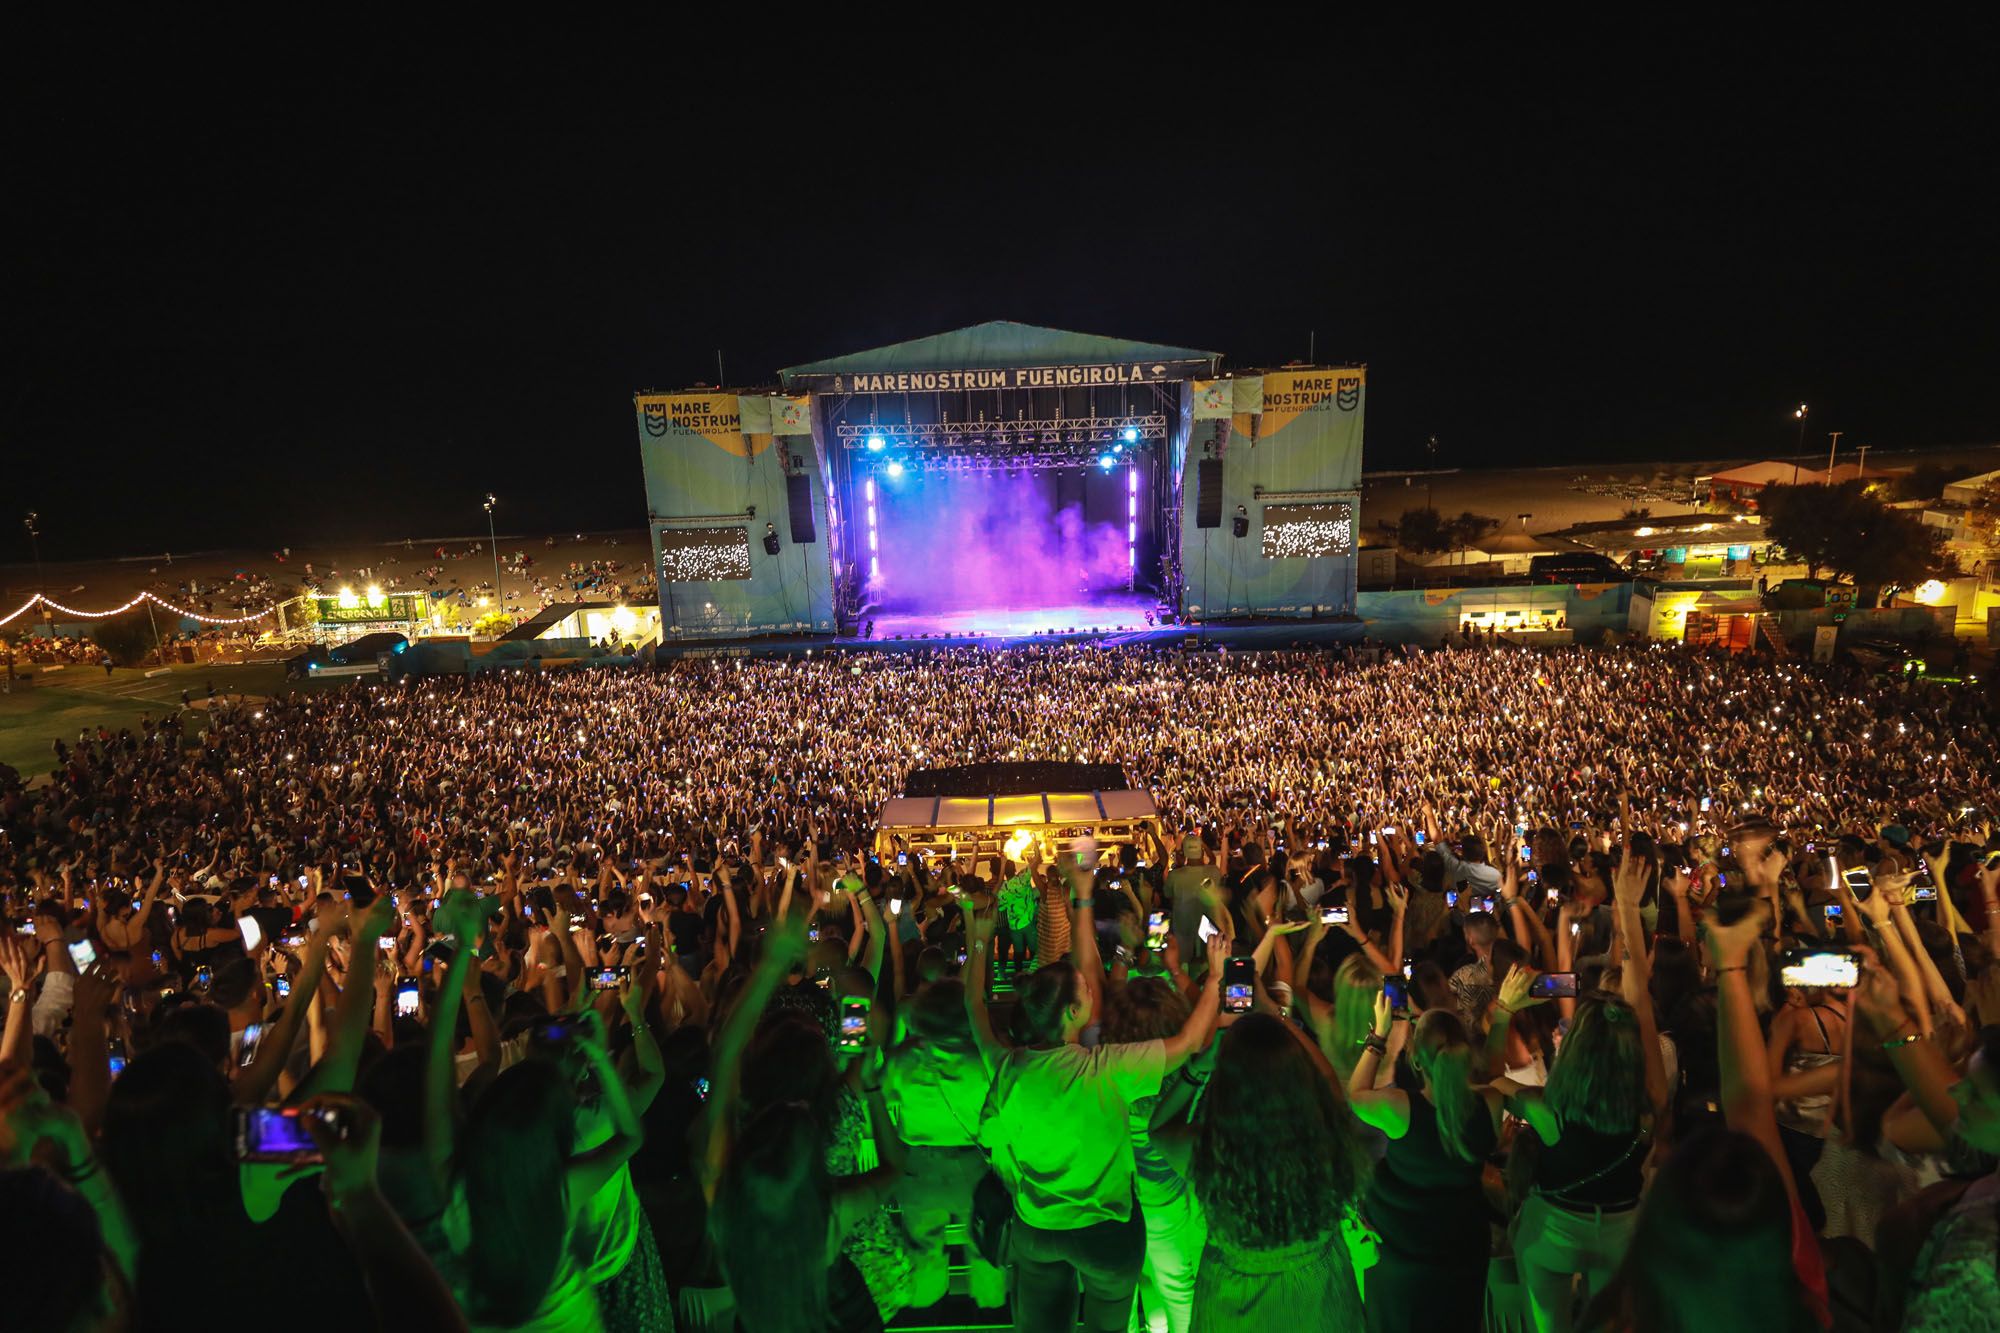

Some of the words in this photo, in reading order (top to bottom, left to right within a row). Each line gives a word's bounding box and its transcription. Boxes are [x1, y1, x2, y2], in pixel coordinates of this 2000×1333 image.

[853, 371, 1006, 391] MARENOSTRUM
[1016, 365, 1143, 386] FUENGIROLA
[1293, 378, 1333, 391] MARE
[1264, 392, 1332, 405] NOSTRUM
[671, 402, 711, 415] MARE
[1274, 404, 1331, 413] FUENGIROLA
[672, 414, 740, 428] NOSTRUM
[673, 428, 729, 436] FUENGIROLA
[327, 609, 389, 619] EMERGENCIA
